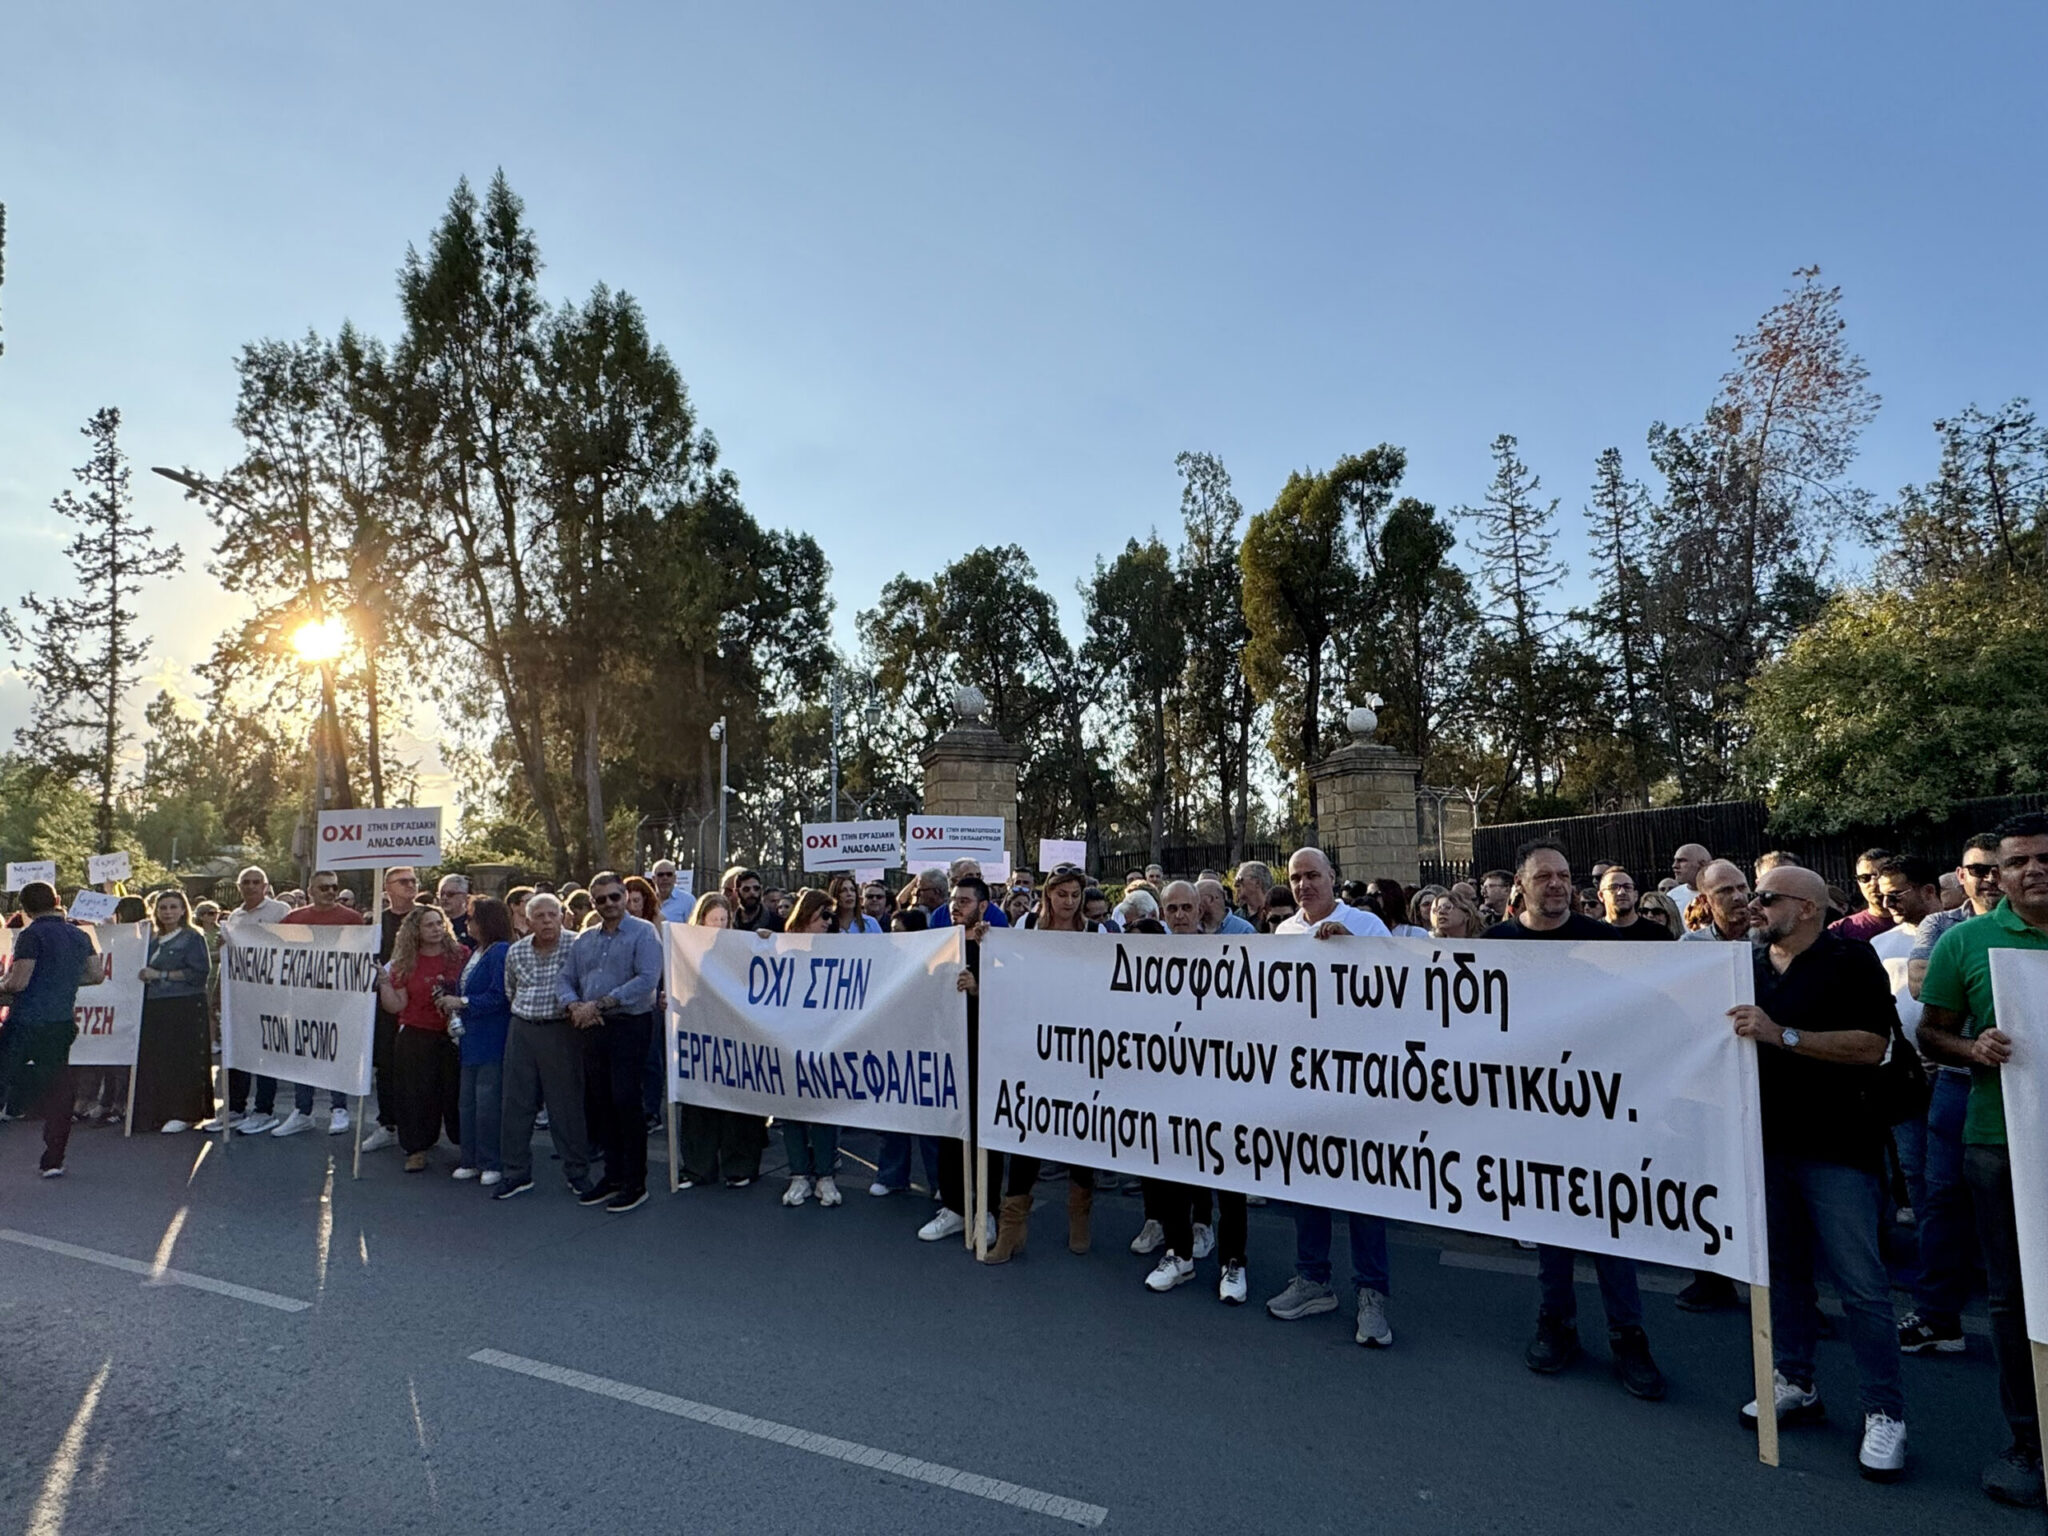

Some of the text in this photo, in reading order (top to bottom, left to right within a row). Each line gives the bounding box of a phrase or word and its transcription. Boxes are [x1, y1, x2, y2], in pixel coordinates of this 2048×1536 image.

[322, 824, 362, 842] ΟΧΙ
[367, 821, 436, 832] ΣΤΗΝ ΕΡΓΑΣΙΑΚΗ
[841, 832, 895, 841] ΣΤΗΝ ΕΡΓΑΣΙΑΚΗ
[912, 826, 943, 840] ΟΧΙ
[367, 835, 436, 848] ΑΝΑΣΦΑΛΕΙΑ
[806, 834, 837, 849] ΟΧΙ
[842, 843, 895, 854] ΑΝΑΣΦΑΛΕΙΑ
[227, 945, 277, 985] ΚΑΝΕΝΑΣ
[748, 955, 872, 1010] ΟΧΙ ΣΤΗΝ
[1109, 942, 1510, 1033] Διασφάλιση των ήδη
[260, 1014, 338, 1062] ΣΤΟΝ ΔΡΟΜΟ
[678, 1030, 959, 1110] ΕΡΓΑΣΙΑΚΗ ΑΝΑΣΦΑΛΕΙΑ
[1036, 1021, 1638, 1123] υπηρετούντων εκπαιδευτικών.
[993, 1078, 1734, 1255] Αξιοποίηση της εργασιακής εμπειρίας.
